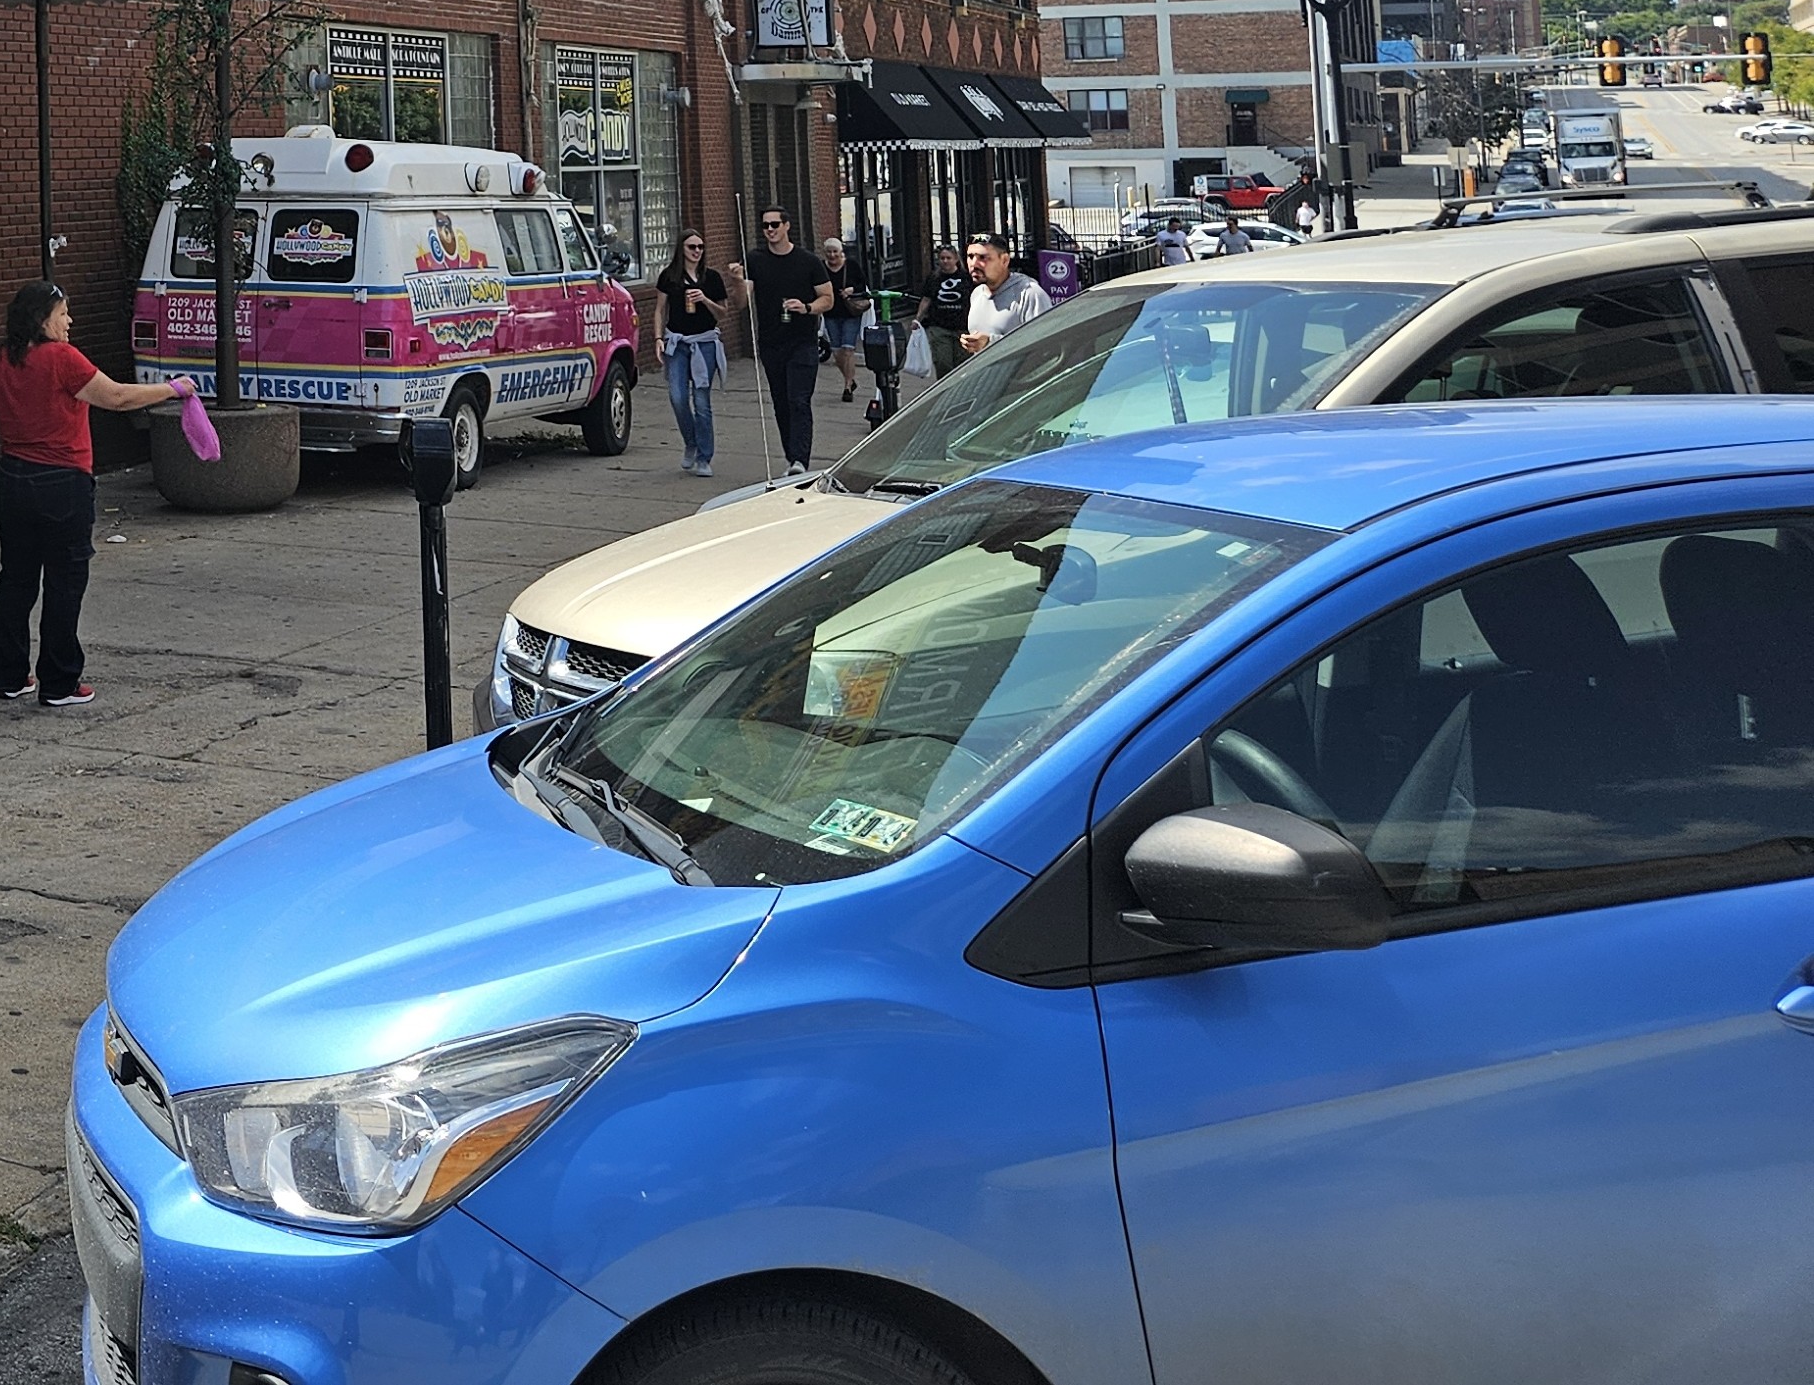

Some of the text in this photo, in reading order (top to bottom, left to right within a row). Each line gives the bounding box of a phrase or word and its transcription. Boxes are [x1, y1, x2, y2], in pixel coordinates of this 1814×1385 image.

[771, 21, 812, 40] Damn
[276, 240, 353, 253] HOLLYWOOD CANDY
[410, 274, 506, 312] HOLLYWOOD CANDY
[1050, 286, 1069, 295] PAY
[167, 297, 190, 307] 1209
[192, 298, 216, 308] JACK
[1051, 297, 1066, 305] HER
[167, 308, 252, 324] OLD MAET
[583, 303, 612, 325] CANDY
[583, 323, 613, 344] RESCUE
[259, 377, 350, 401] RESCUE
[404, 379, 418, 390] 1209
[418, 377, 440, 389] JACKSON
[496, 362, 589, 404] EMERGENCY
[403, 387, 446, 404] OLD MARKET
